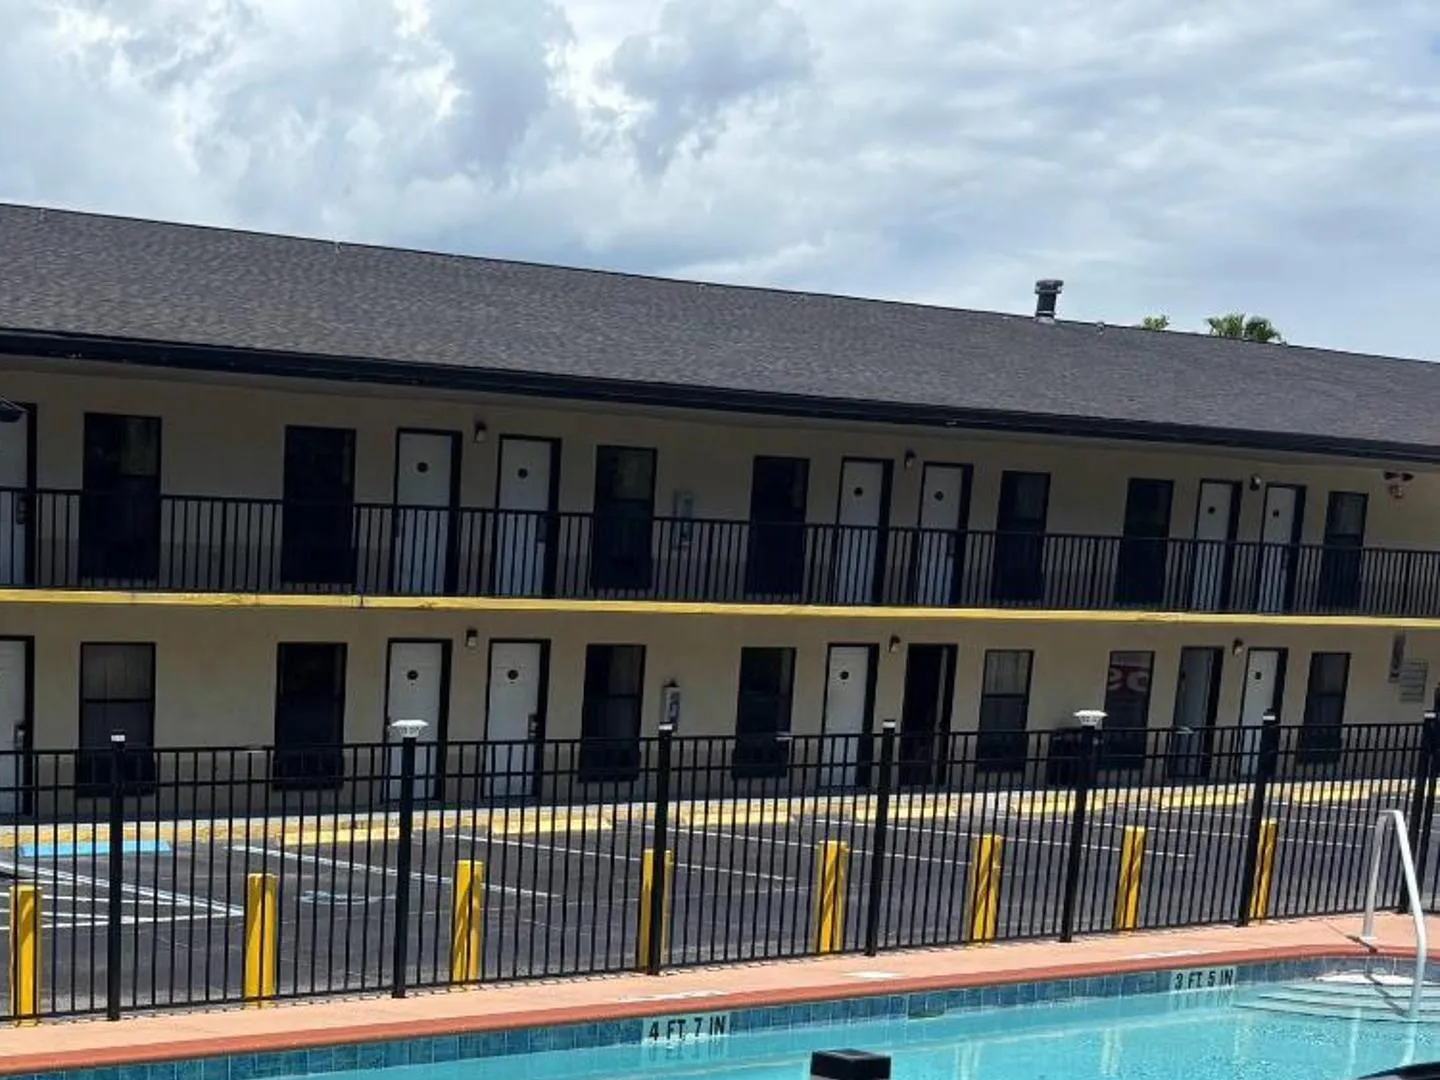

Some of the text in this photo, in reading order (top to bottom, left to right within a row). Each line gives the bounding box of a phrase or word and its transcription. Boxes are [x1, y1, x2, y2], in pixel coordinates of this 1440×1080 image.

[1175, 973, 1184, 990] 3
[1220, 968, 1234, 986] IN
[649, 1020, 659, 1041] 4
[694, 1017, 704, 1037] 7
[709, 1015, 726, 1035] IN
